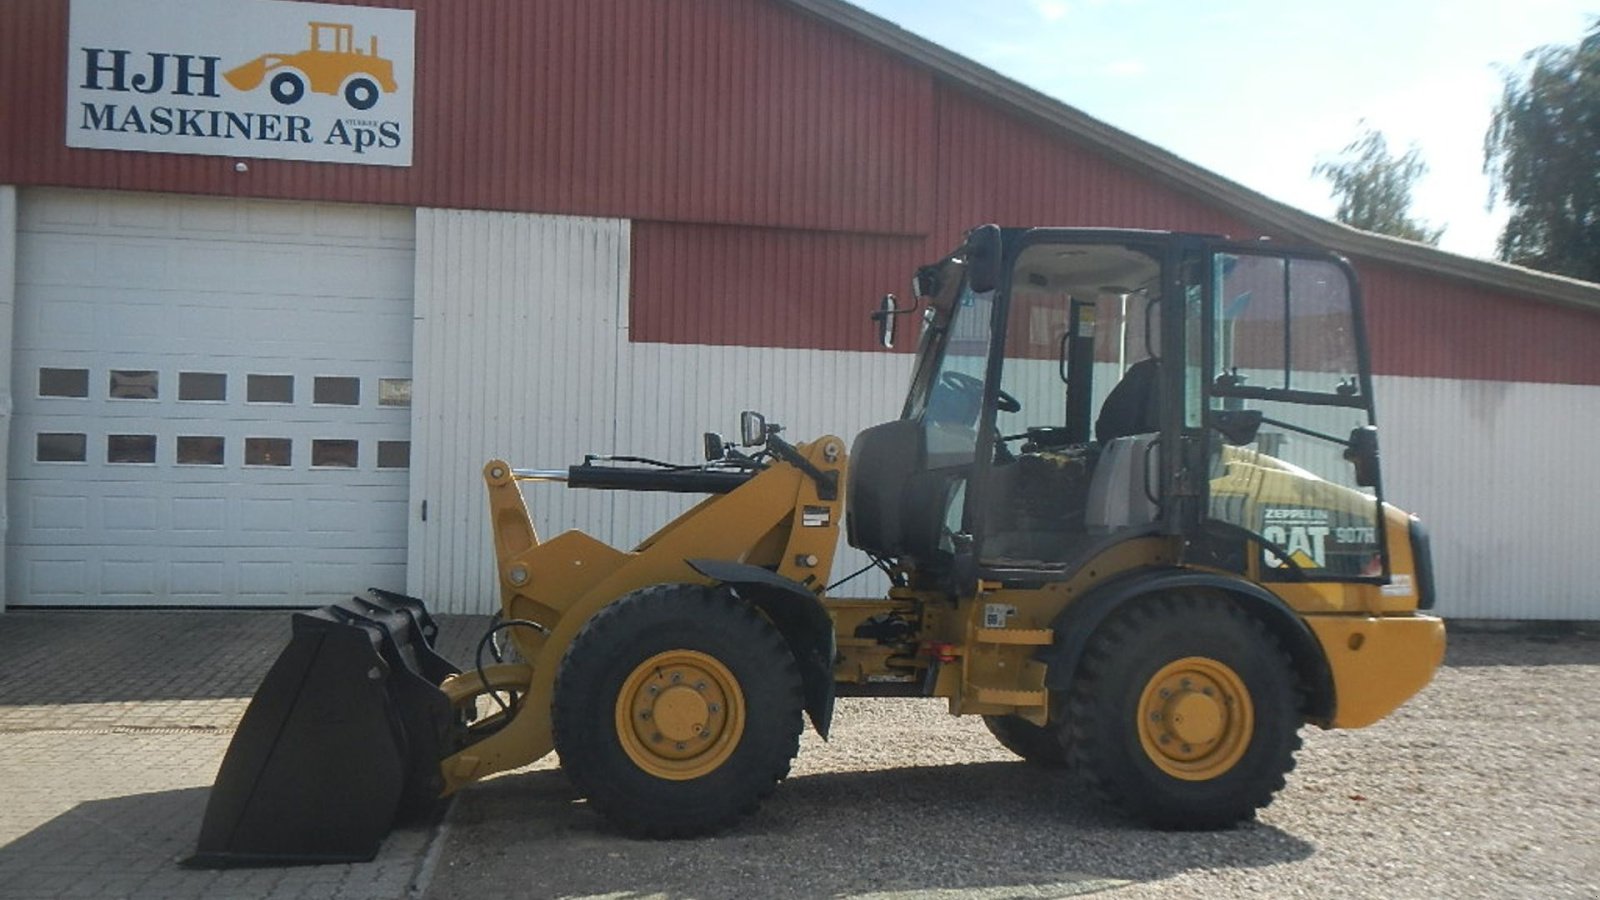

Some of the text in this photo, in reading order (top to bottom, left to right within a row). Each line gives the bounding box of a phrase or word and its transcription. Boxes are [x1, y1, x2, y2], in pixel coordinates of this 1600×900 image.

[80, 47, 221, 97] HJH
[80, 102, 401, 154] MASKINER ApS
[1264, 509, 1328, 519] ZEPPELIN
[1264, 525, 1330, 569] CAT
